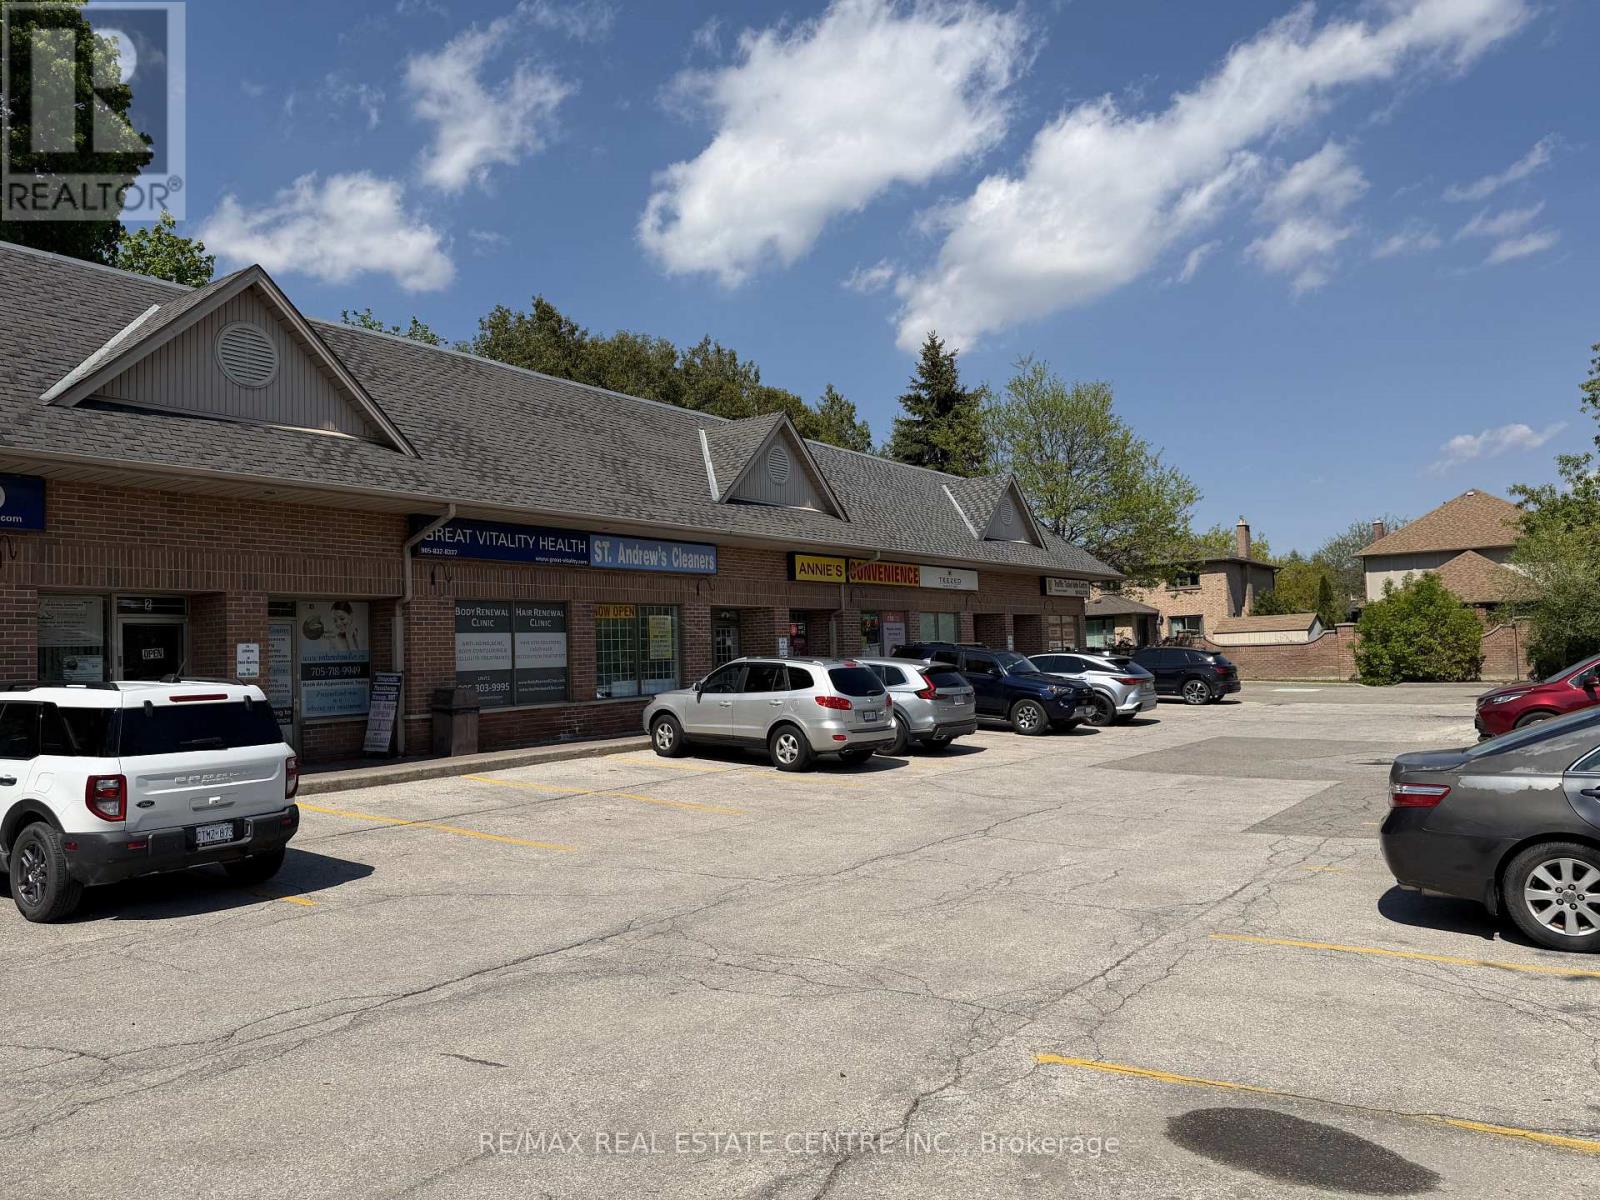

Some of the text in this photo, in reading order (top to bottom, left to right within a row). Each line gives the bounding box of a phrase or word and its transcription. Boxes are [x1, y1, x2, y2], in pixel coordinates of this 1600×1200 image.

[476, 530, 536, 549] VITALITY
[540, 537, 586, 553] HEALTH
[594, 540, 715, 570] ST. Andrew's Cleaners
[799, 562, 843, 577] ANNIE'S
[849, 562, 919, 585] CONVENIENCE
[145, 599, 152, 610] 2
[455, 607, 509, 617] BODY RENEWAL
[516, 607, 564, 618] HAIR RENEWAL
[613, 606, 635, 618] OPEN
[471, 617, 495, 628] CLINIC
[530, 618, 552, 628] CLINIC
[143, 648, 164, 659] OPEN
